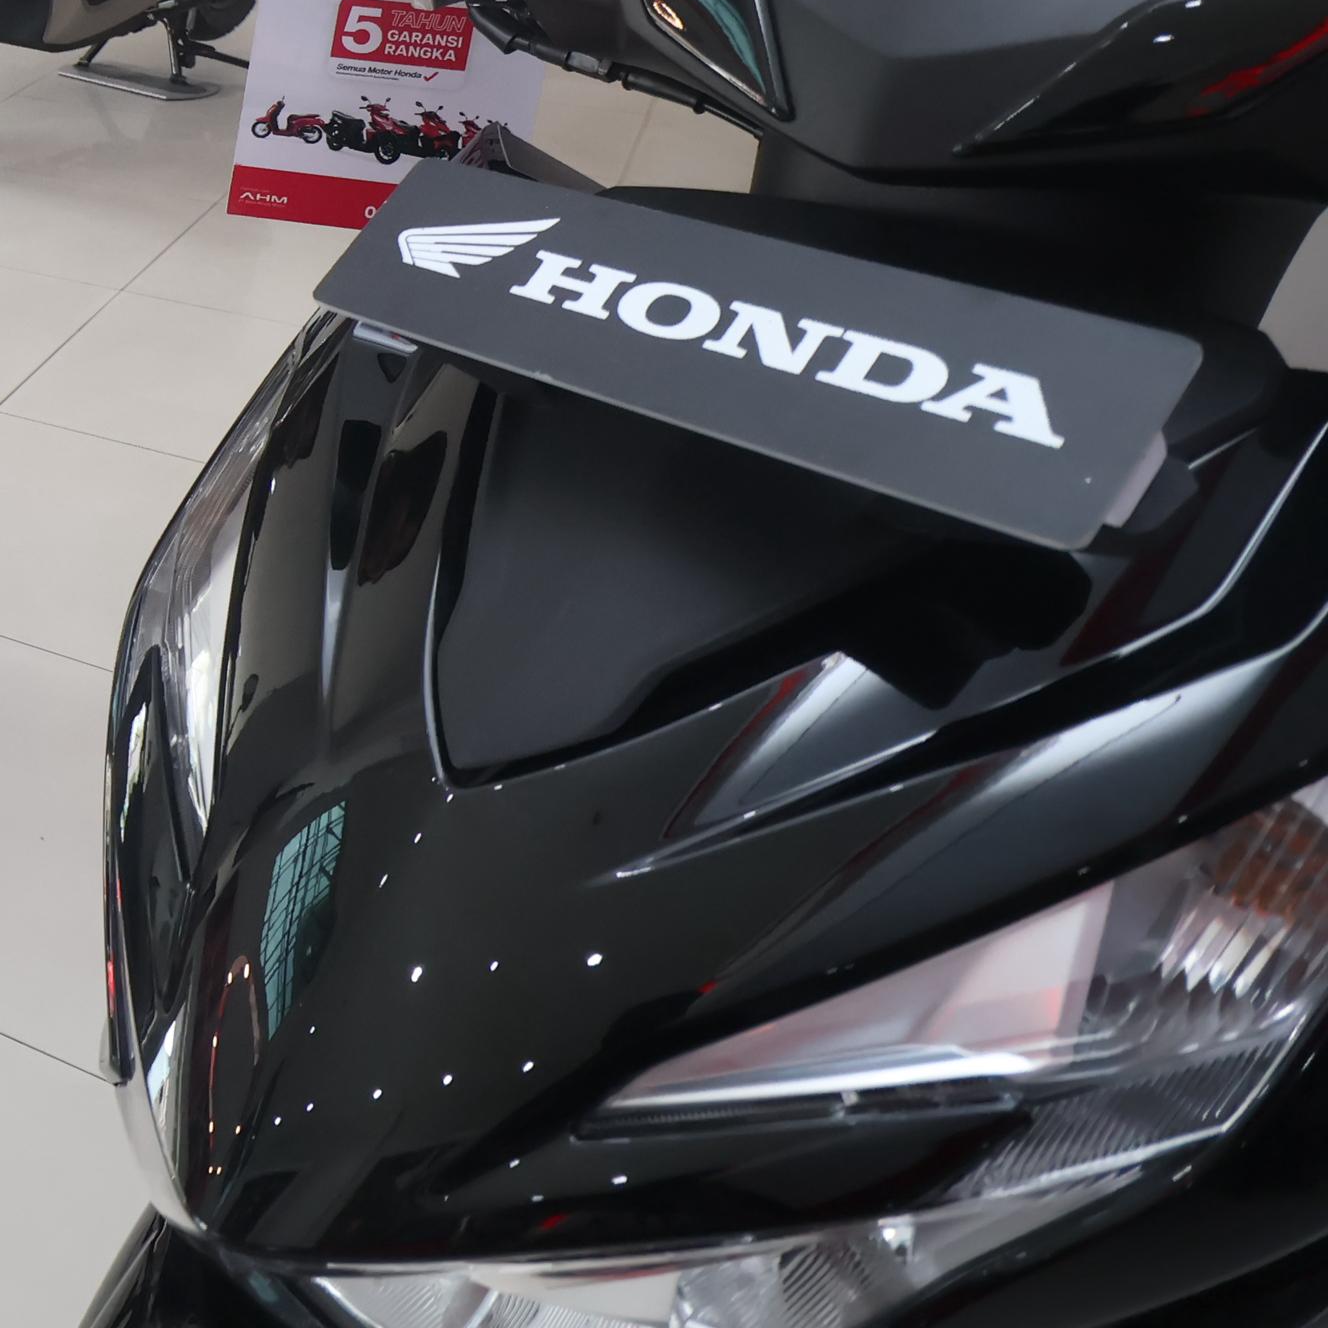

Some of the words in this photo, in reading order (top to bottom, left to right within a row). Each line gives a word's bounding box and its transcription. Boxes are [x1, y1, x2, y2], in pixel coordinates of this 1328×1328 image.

[341, 5, 384, 55] 5
[391, 10, 467, 33] TAHUN
[387, 30, 464, 49] GARANSI
[384, 43, 457, 62] RANGKA
[336, 63, 367, 73] Semua
[367, 67, 393, 76] Motor
[393, 69, 423, 80] Honda
[240, 191, 289, 205] AHM
[509, 249, 1065, 449] HONDA
